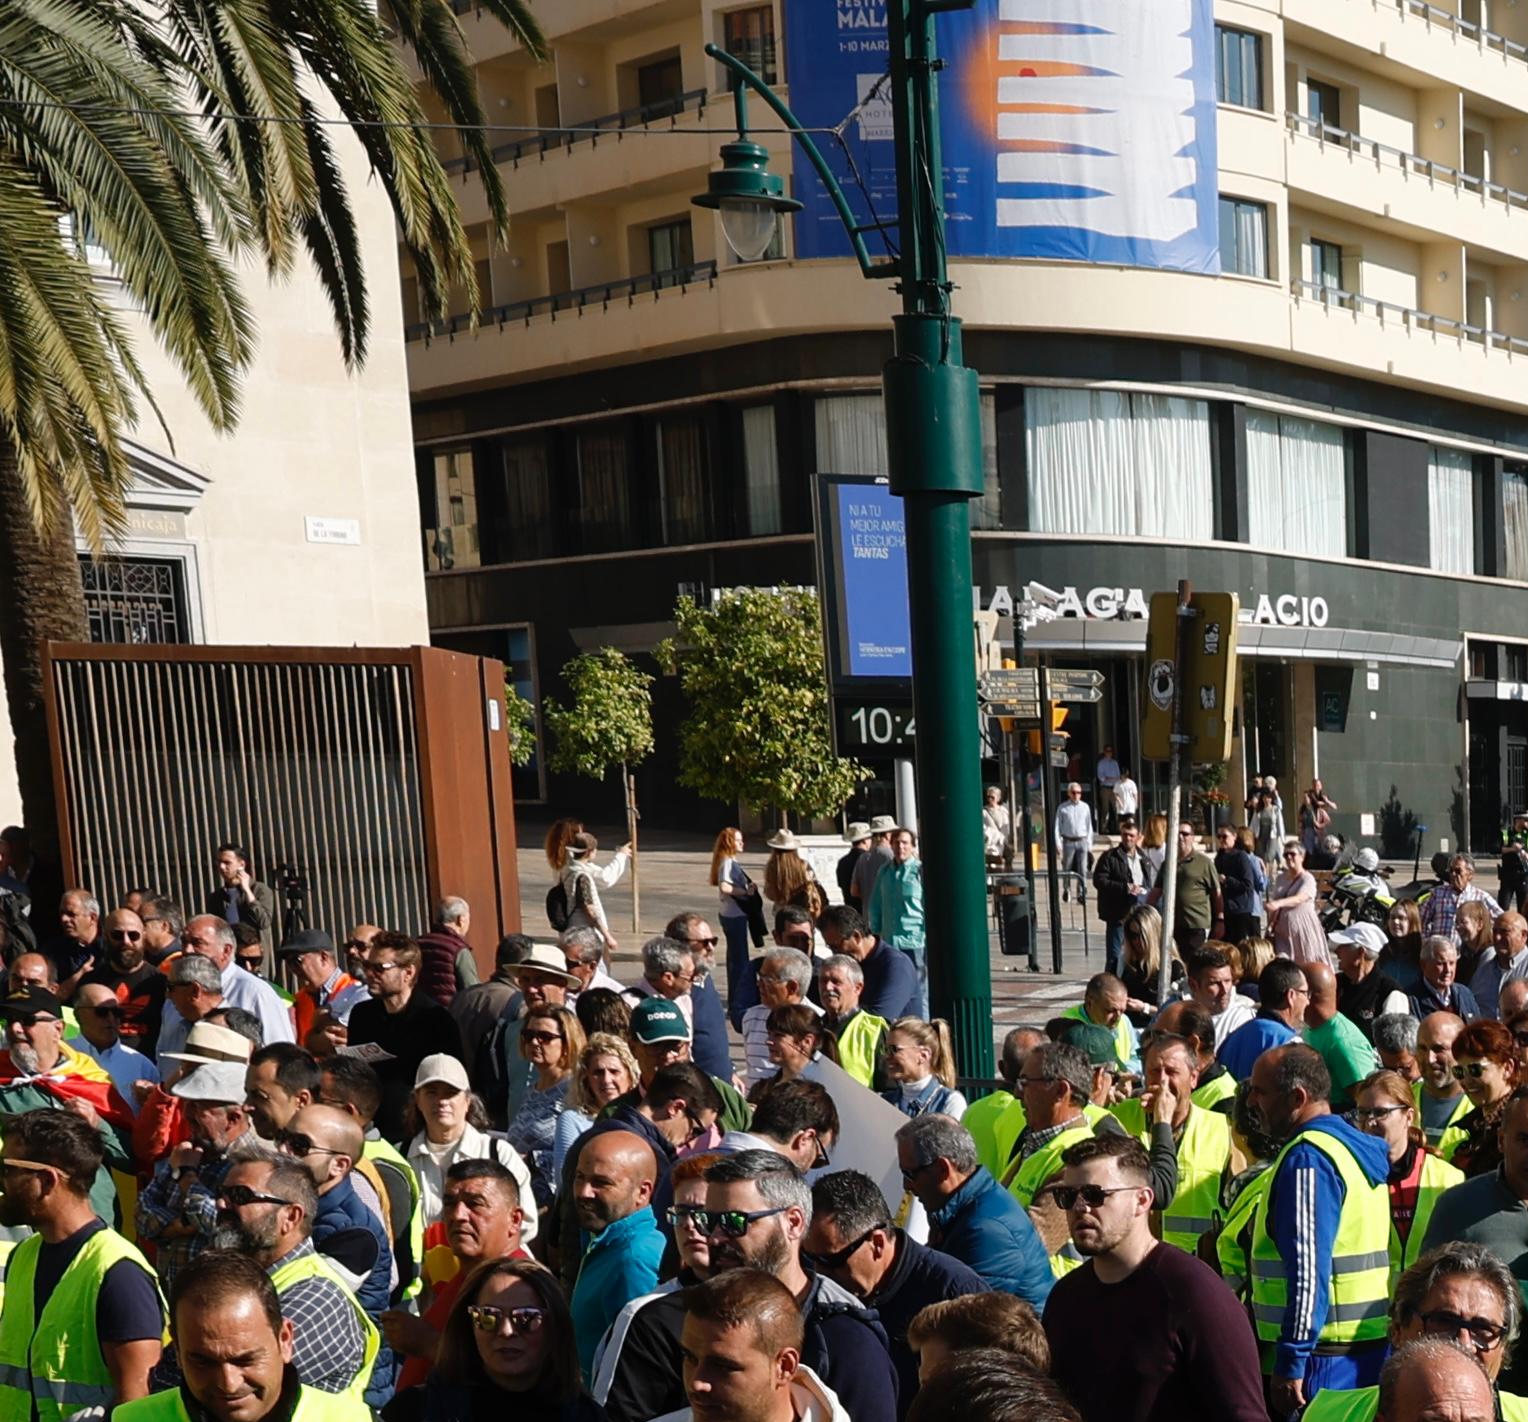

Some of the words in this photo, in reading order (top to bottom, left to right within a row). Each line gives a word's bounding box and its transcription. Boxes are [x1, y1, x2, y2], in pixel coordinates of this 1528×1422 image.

[837, 0, 885, 8] FESTIV
[860, 40, 890, 51] MARZ
[132, 513, 177, 536] nicaja
[880, 520, 904, 533] AMIG
[853, 546, 889, 560] TANTAS
[973, 586, 1149, 619] AAGA
[1239, 593, 1330, 627] ACIO
[852, 707, 916, 744] 10:4
